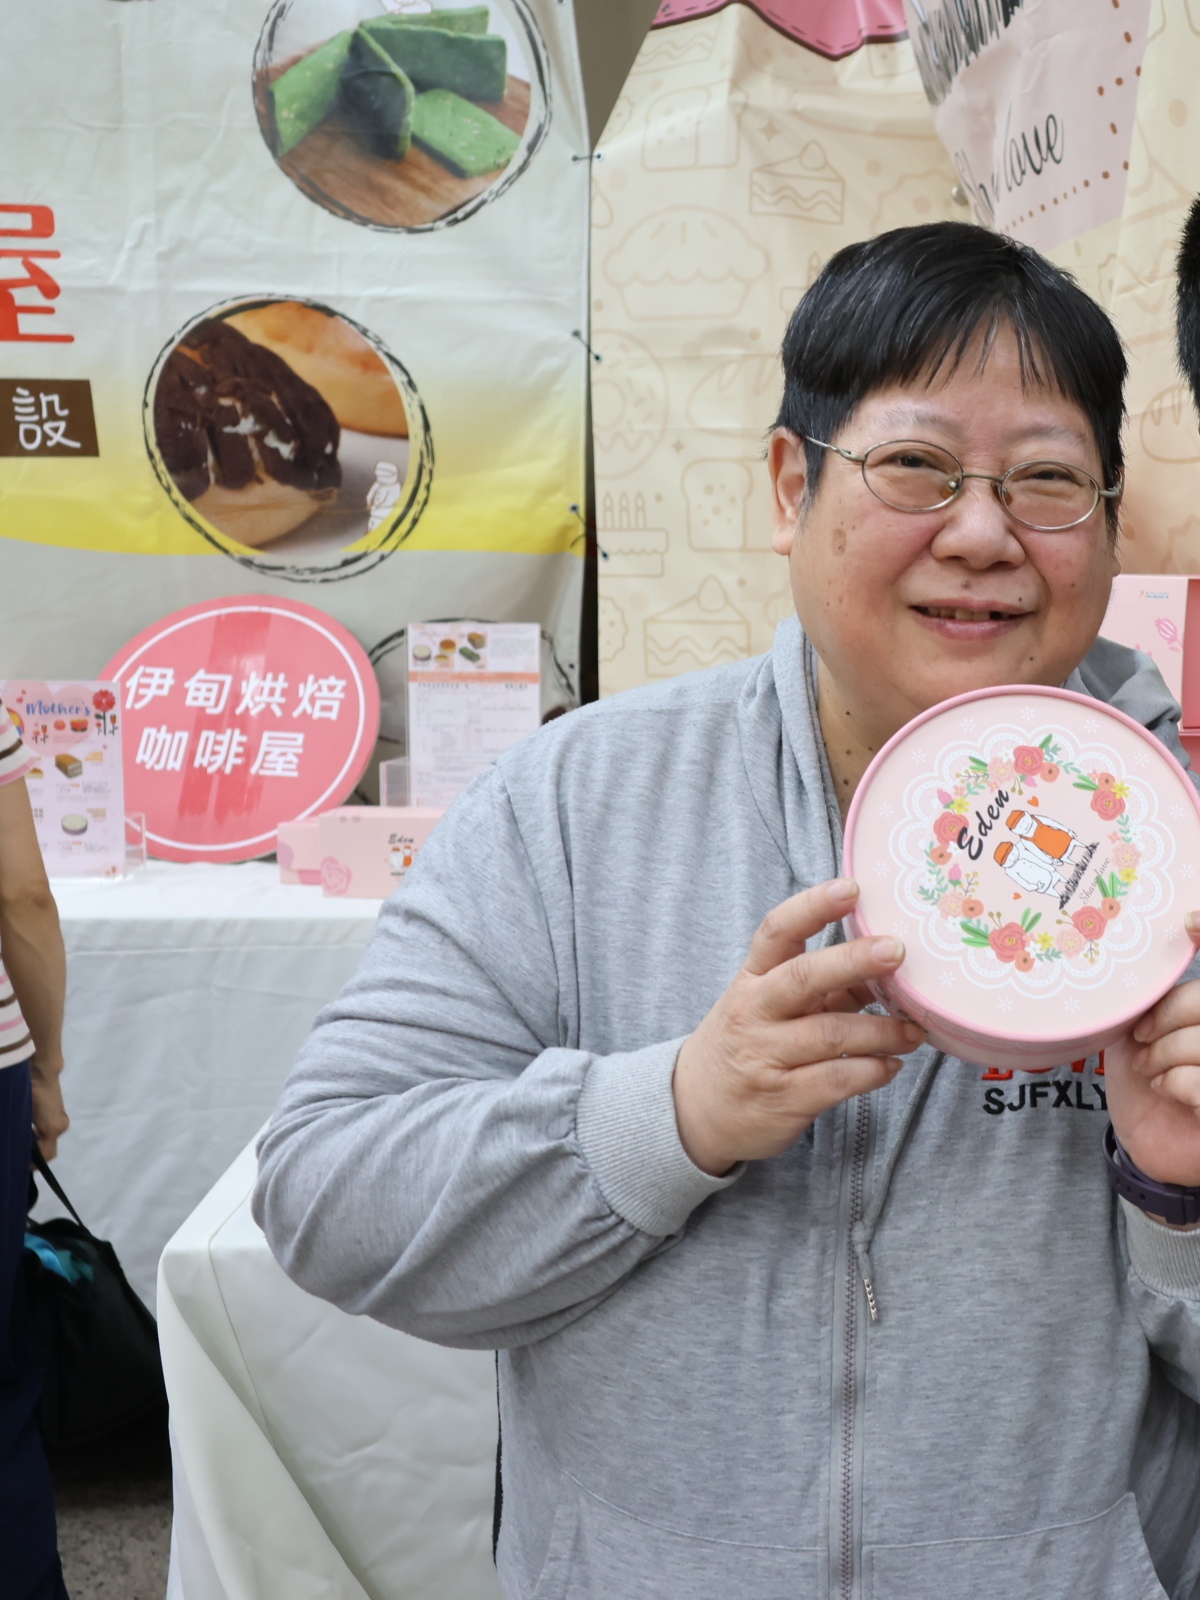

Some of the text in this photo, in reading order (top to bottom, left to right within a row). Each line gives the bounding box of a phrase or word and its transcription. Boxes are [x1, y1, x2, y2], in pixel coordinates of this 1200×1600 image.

[12, 386, 81, 450] 設
[125, 665, 347, 720] 伊甸烘焙
[135, 725, 305, 777] 咖啡屋
[957, 789, 1010, 861] Eden
